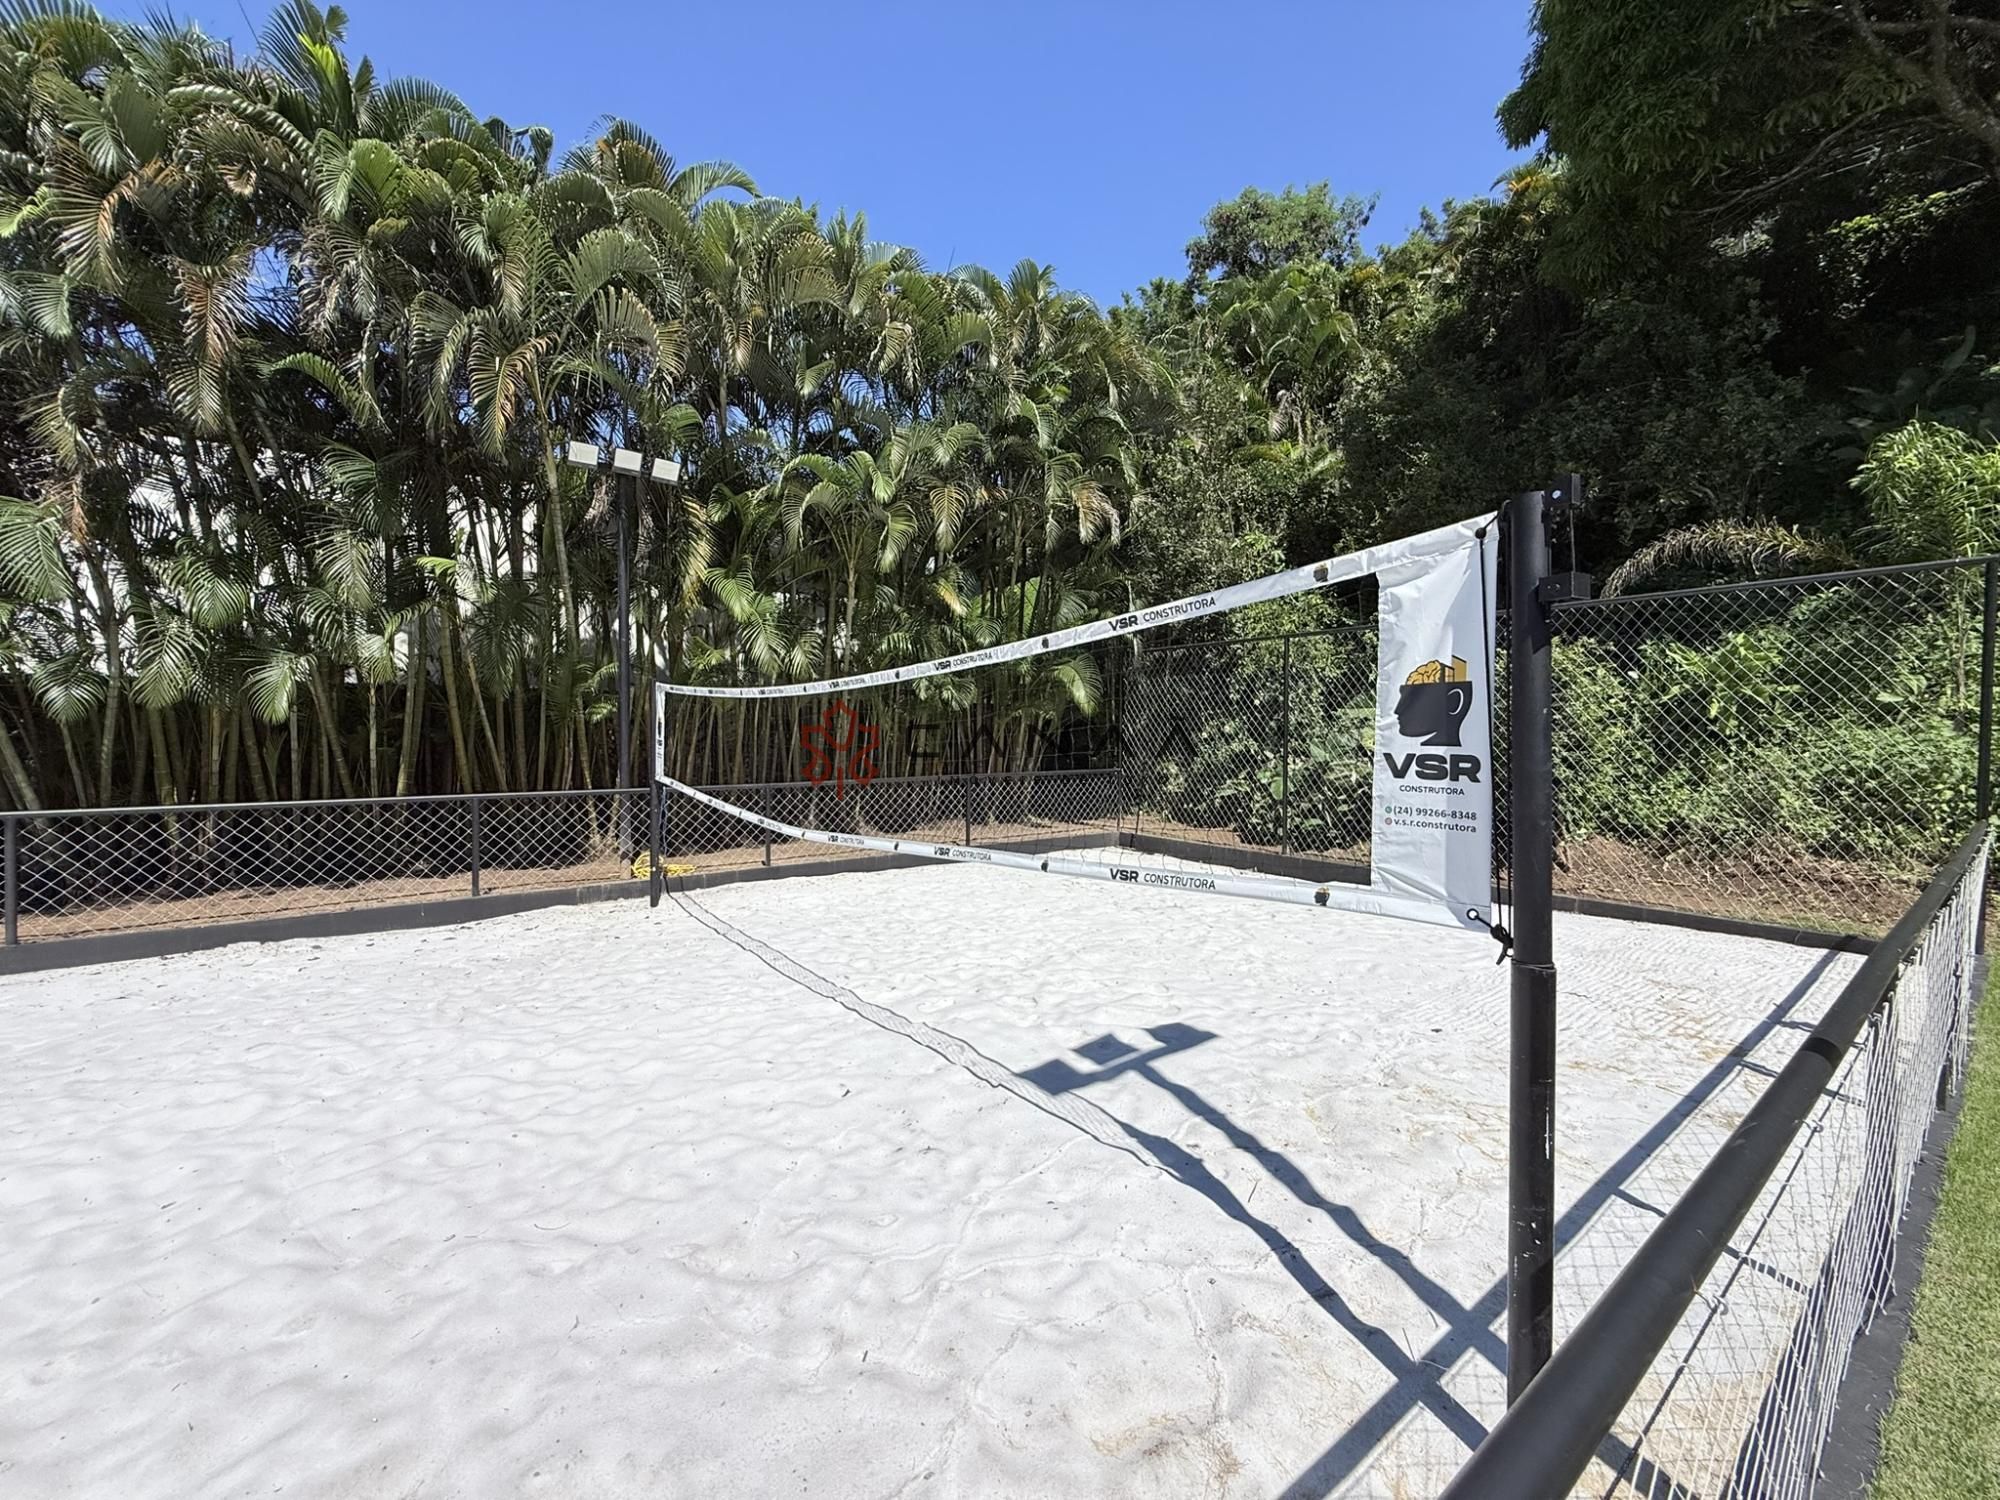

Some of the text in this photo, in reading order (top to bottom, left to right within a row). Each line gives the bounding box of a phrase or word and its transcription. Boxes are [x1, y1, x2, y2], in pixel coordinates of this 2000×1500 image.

[1108, 597, 1216, 631] VSR CONSTRUTORA
[1382, 752, 1481, 783] VSR
[1399, 785, 1465, 796] CONSTRUTORA
[1393, 806, 1477, 820] (24) 99266-8348
[1393, 818, 1477, 833] v.s.r.construtora
[1109, 868, 1216, 890] VSR CONSTRUTORA
